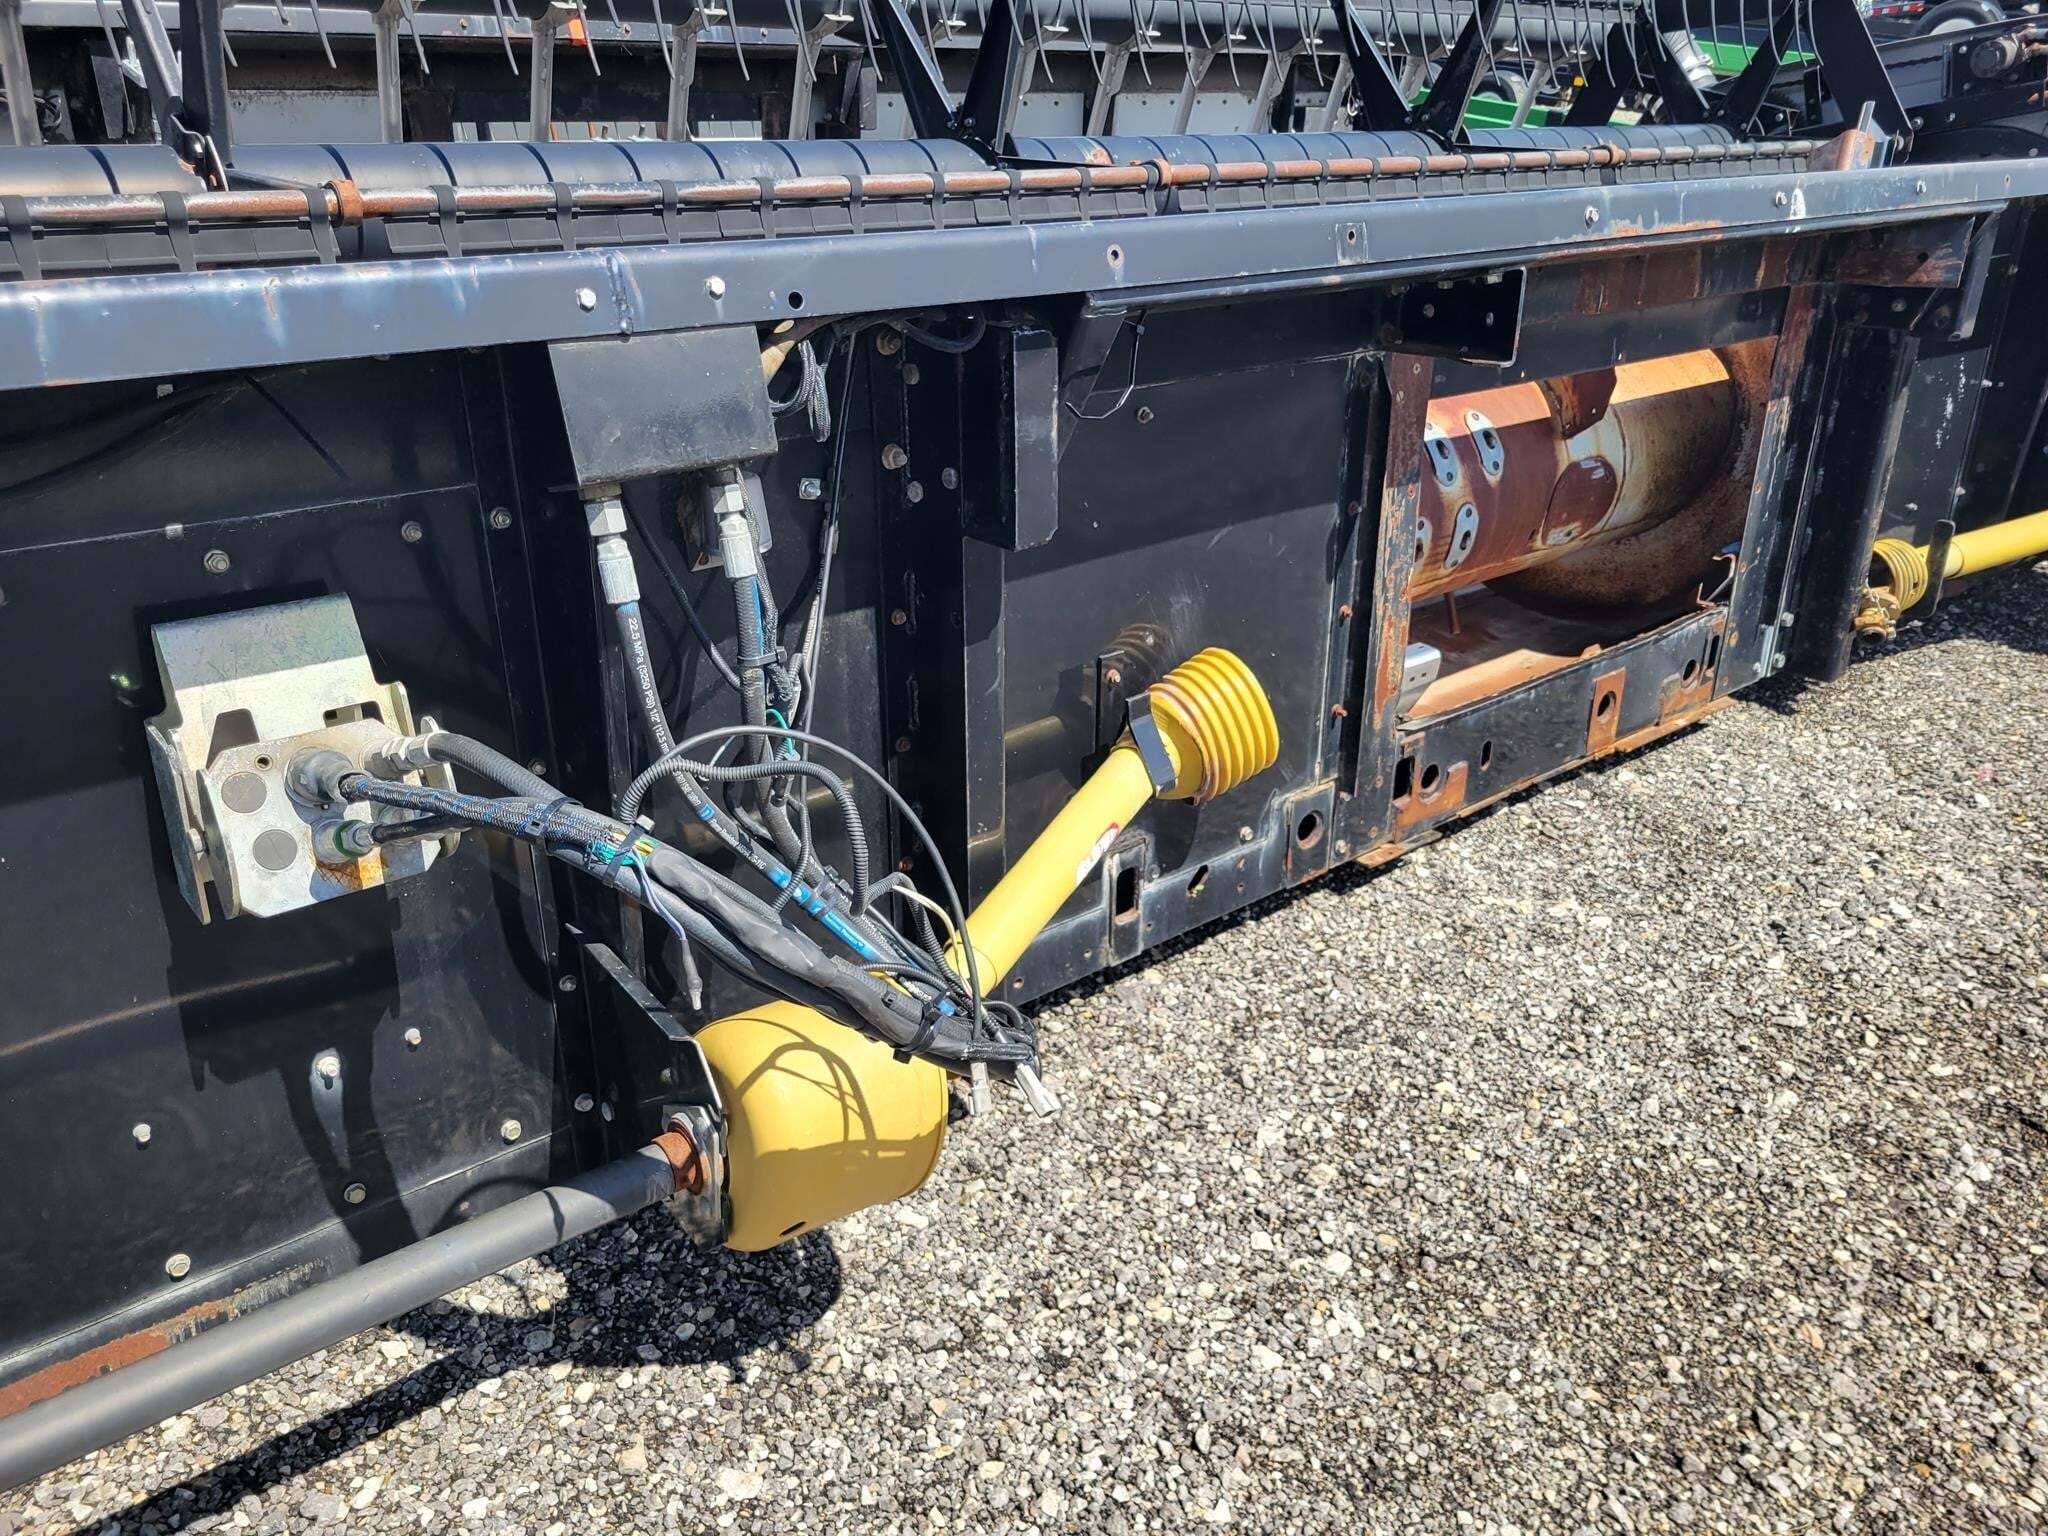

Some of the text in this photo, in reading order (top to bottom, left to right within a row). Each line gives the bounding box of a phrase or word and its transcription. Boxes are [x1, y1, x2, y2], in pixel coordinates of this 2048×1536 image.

[629, 617, 640, 640] 22.5
[633, 641, 644, 664] MPa
[637, 664, 651, 690] (3250
[644, 689, 656, 709] PSI)
